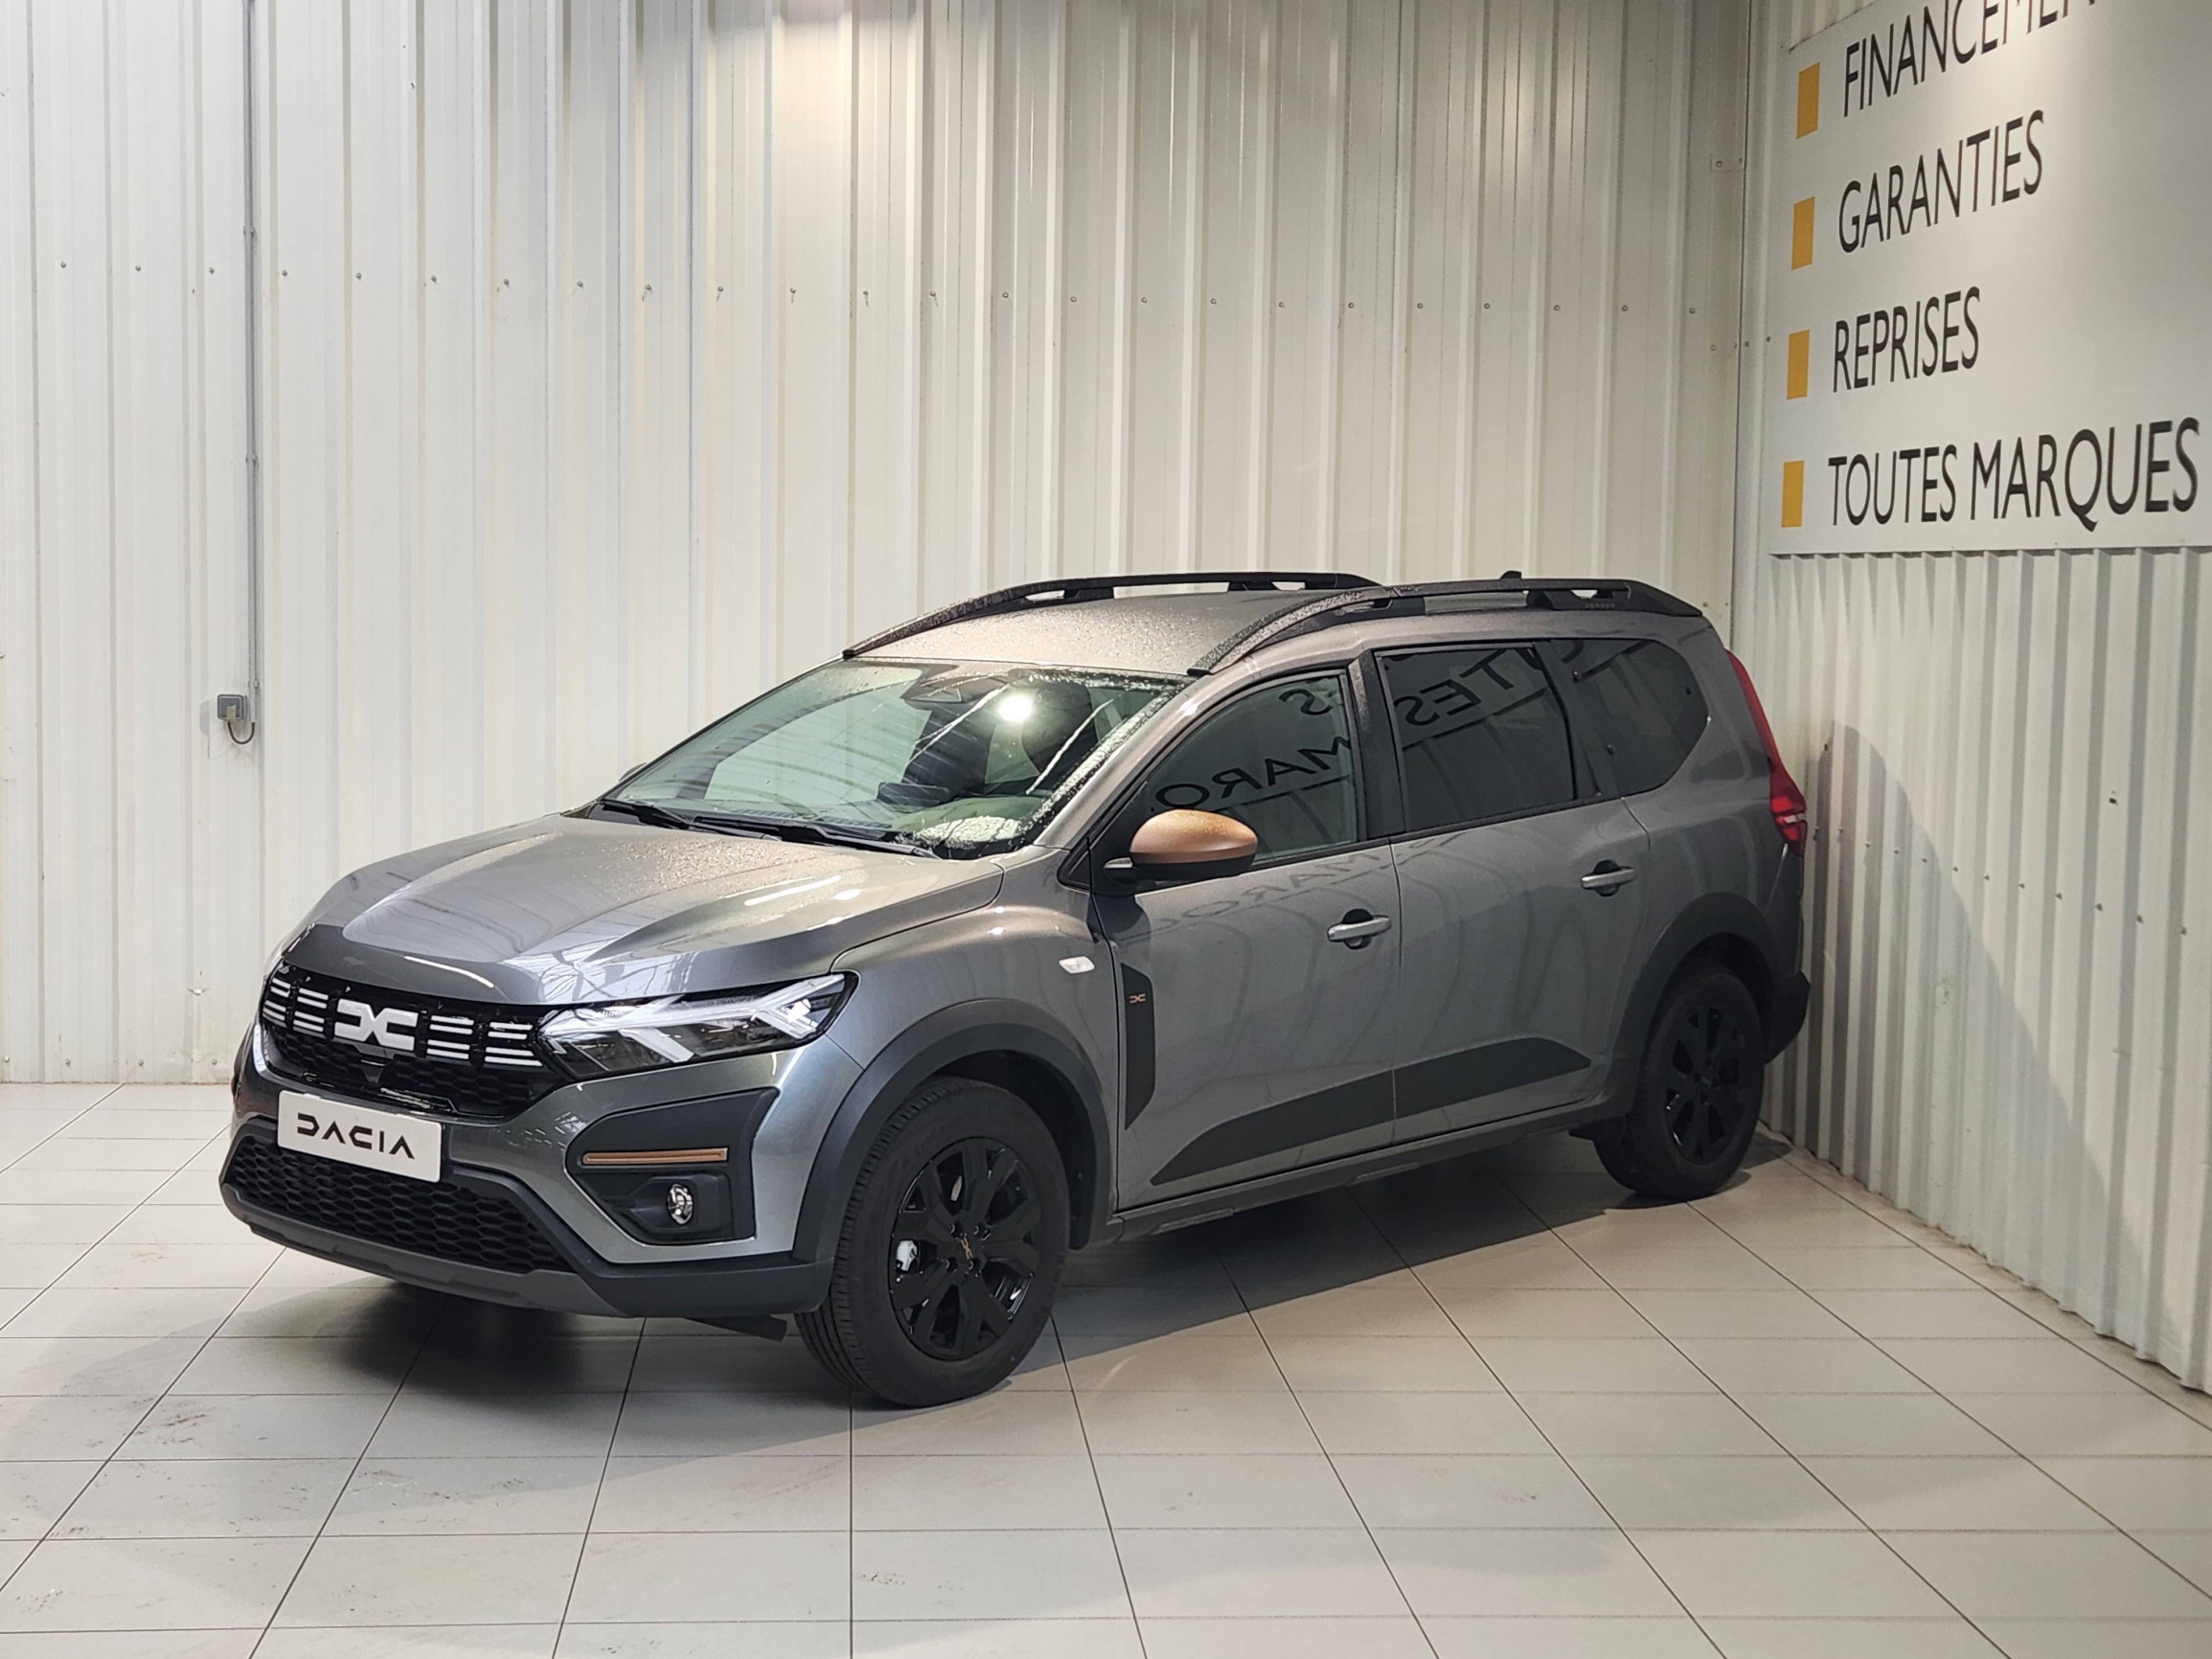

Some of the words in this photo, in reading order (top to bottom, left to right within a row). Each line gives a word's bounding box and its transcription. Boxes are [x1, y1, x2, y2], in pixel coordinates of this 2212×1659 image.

[1843, 0, 2095, 118] FINANCE
[1838, 110, 2044, 253] GARANTIES
[1833, 286, 1980, 393] REPRISES
[1828, 444, 1957, 526] TOUTES
[1970, 417, 2200, 533] MARQUES
[297, 1112, 416, 1160] DACIA
